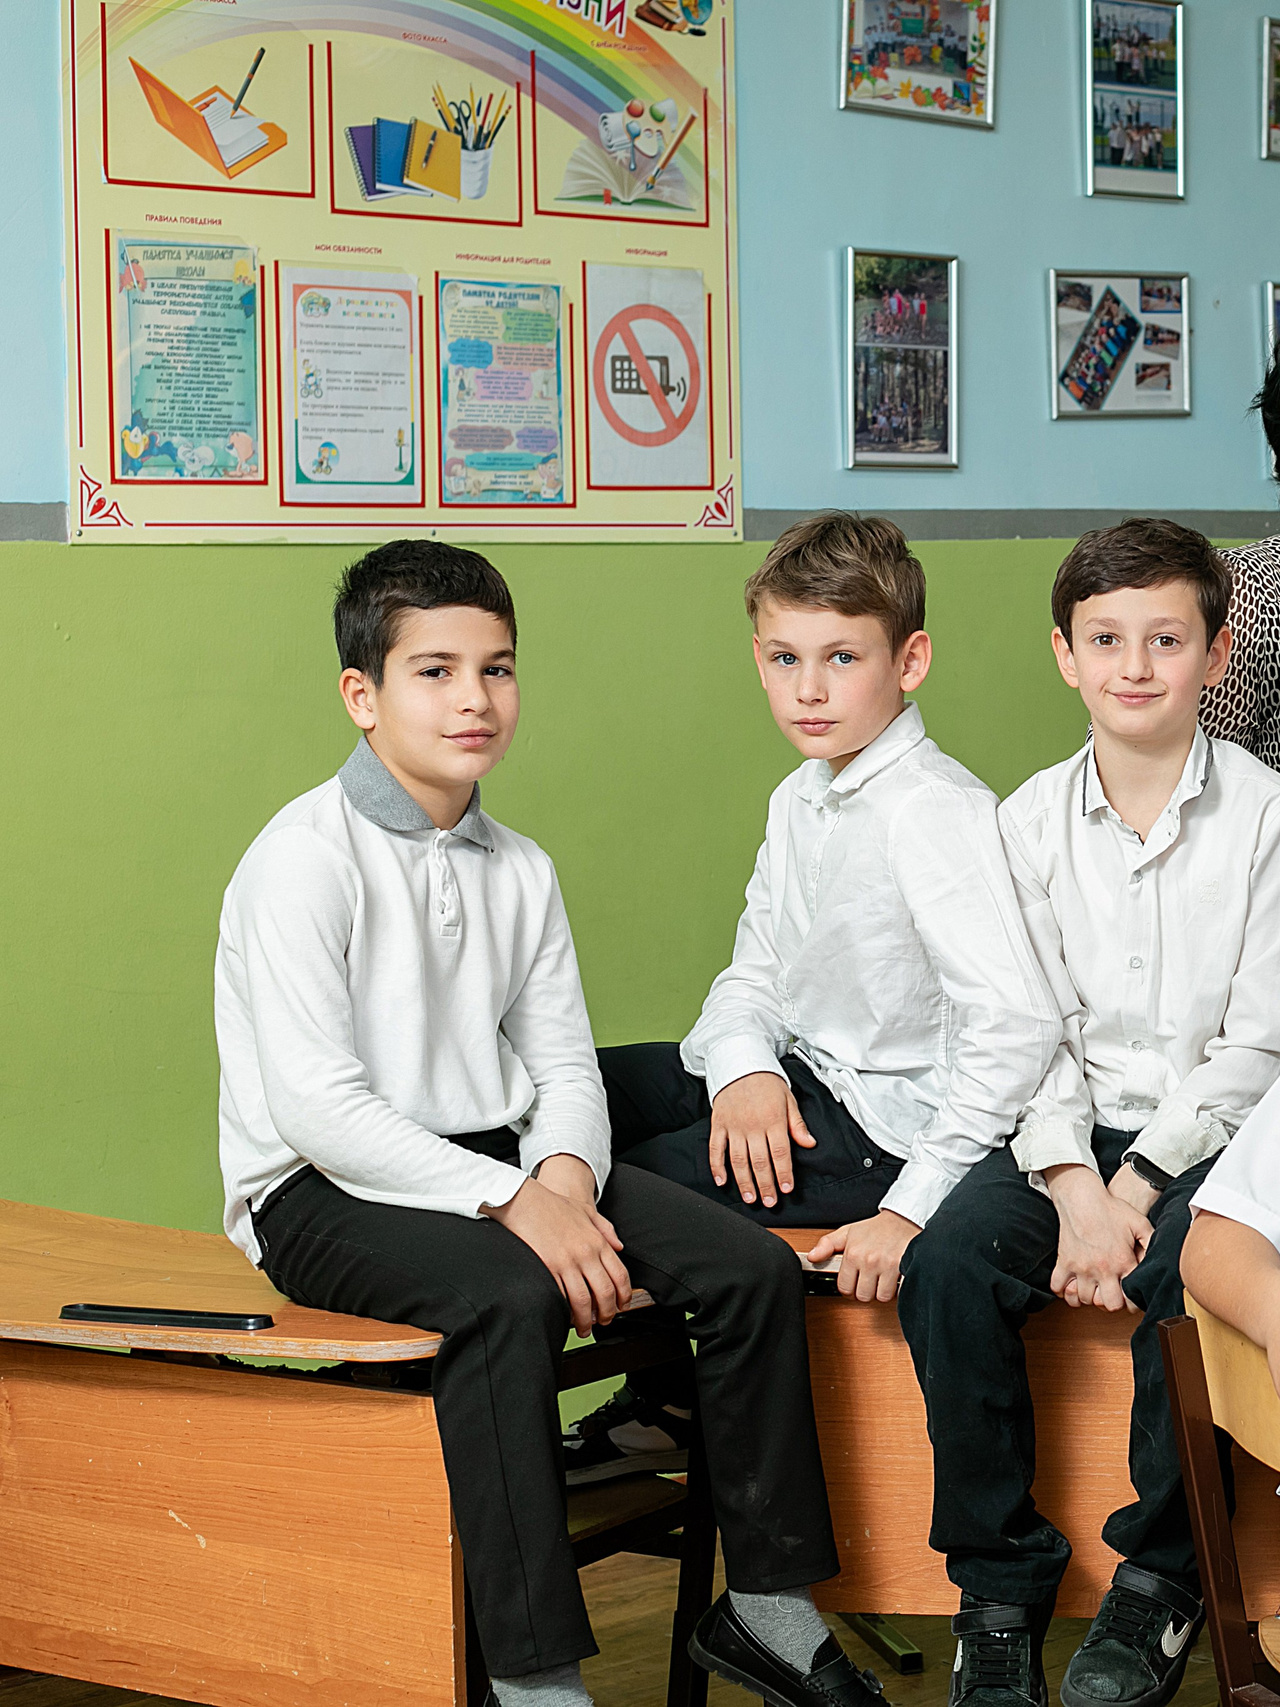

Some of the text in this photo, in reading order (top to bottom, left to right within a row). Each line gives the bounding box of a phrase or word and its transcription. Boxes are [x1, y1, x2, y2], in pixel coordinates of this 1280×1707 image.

[402, 32, 448, 43] ФОТО КЛАССА
[145, 214, 222, 226] ПРАВИЛА ПОВЕДЕНИЯ
[142, 249, 181, 260] ПАМЯТКА
[333, 244, 382, 254] ОБЯЗАННОСТИ
[625, 248, 668, 257] ИНФОРМАЦИЯ
[456, 253, 501, 262] ИНФОРМАЦИЯ
[516, 257, 551, 265] РОДИТЕЛЕЙ
